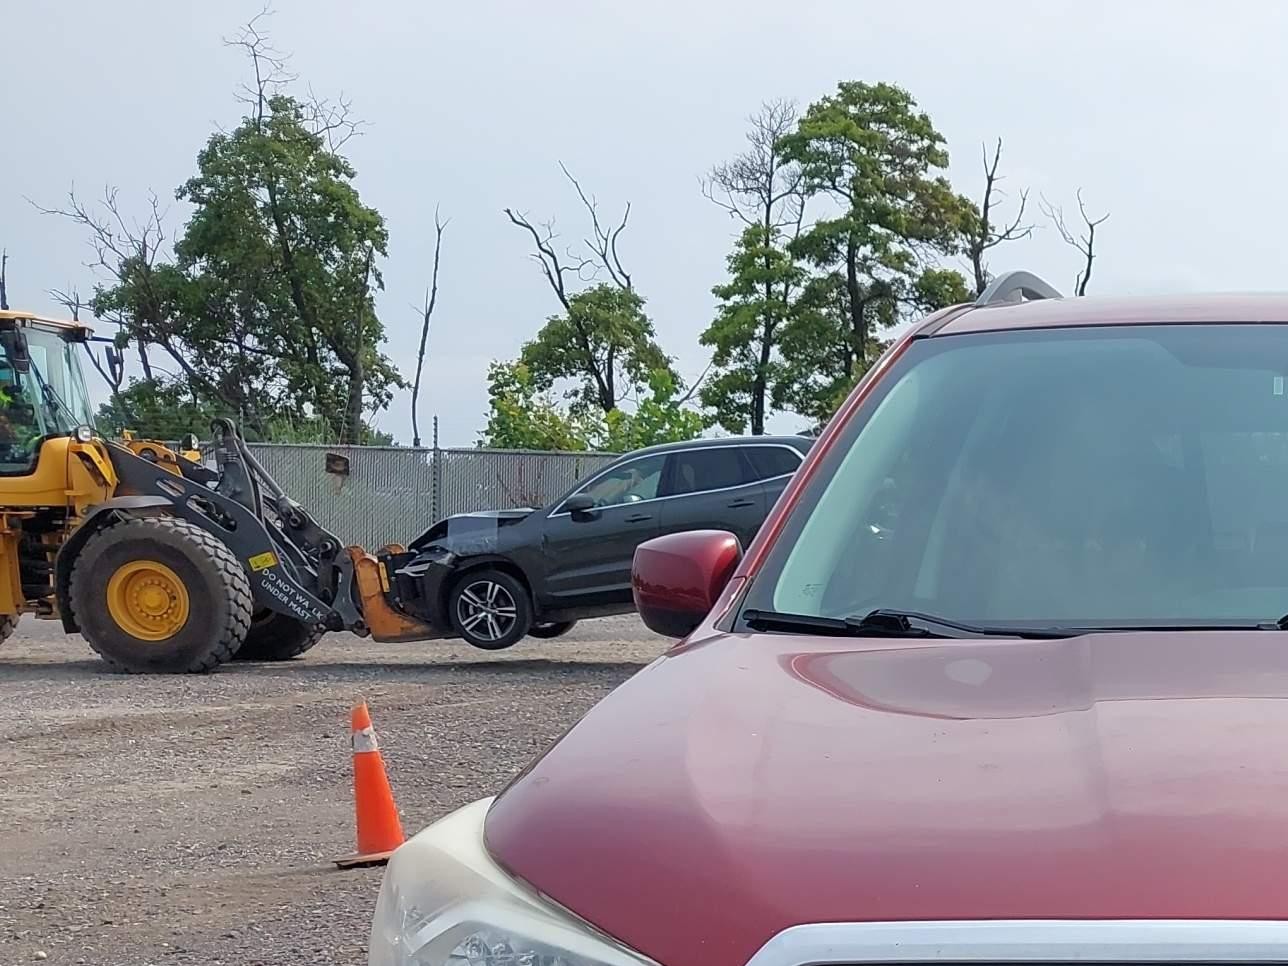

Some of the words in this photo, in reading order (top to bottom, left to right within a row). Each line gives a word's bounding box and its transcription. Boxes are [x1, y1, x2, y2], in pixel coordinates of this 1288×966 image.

[262, 568, 276, 580] DO
[276, 579, 296, 595] NOT
[261, 580, 289, 604] UNDER
[288, 601, 312, 620] MAST
